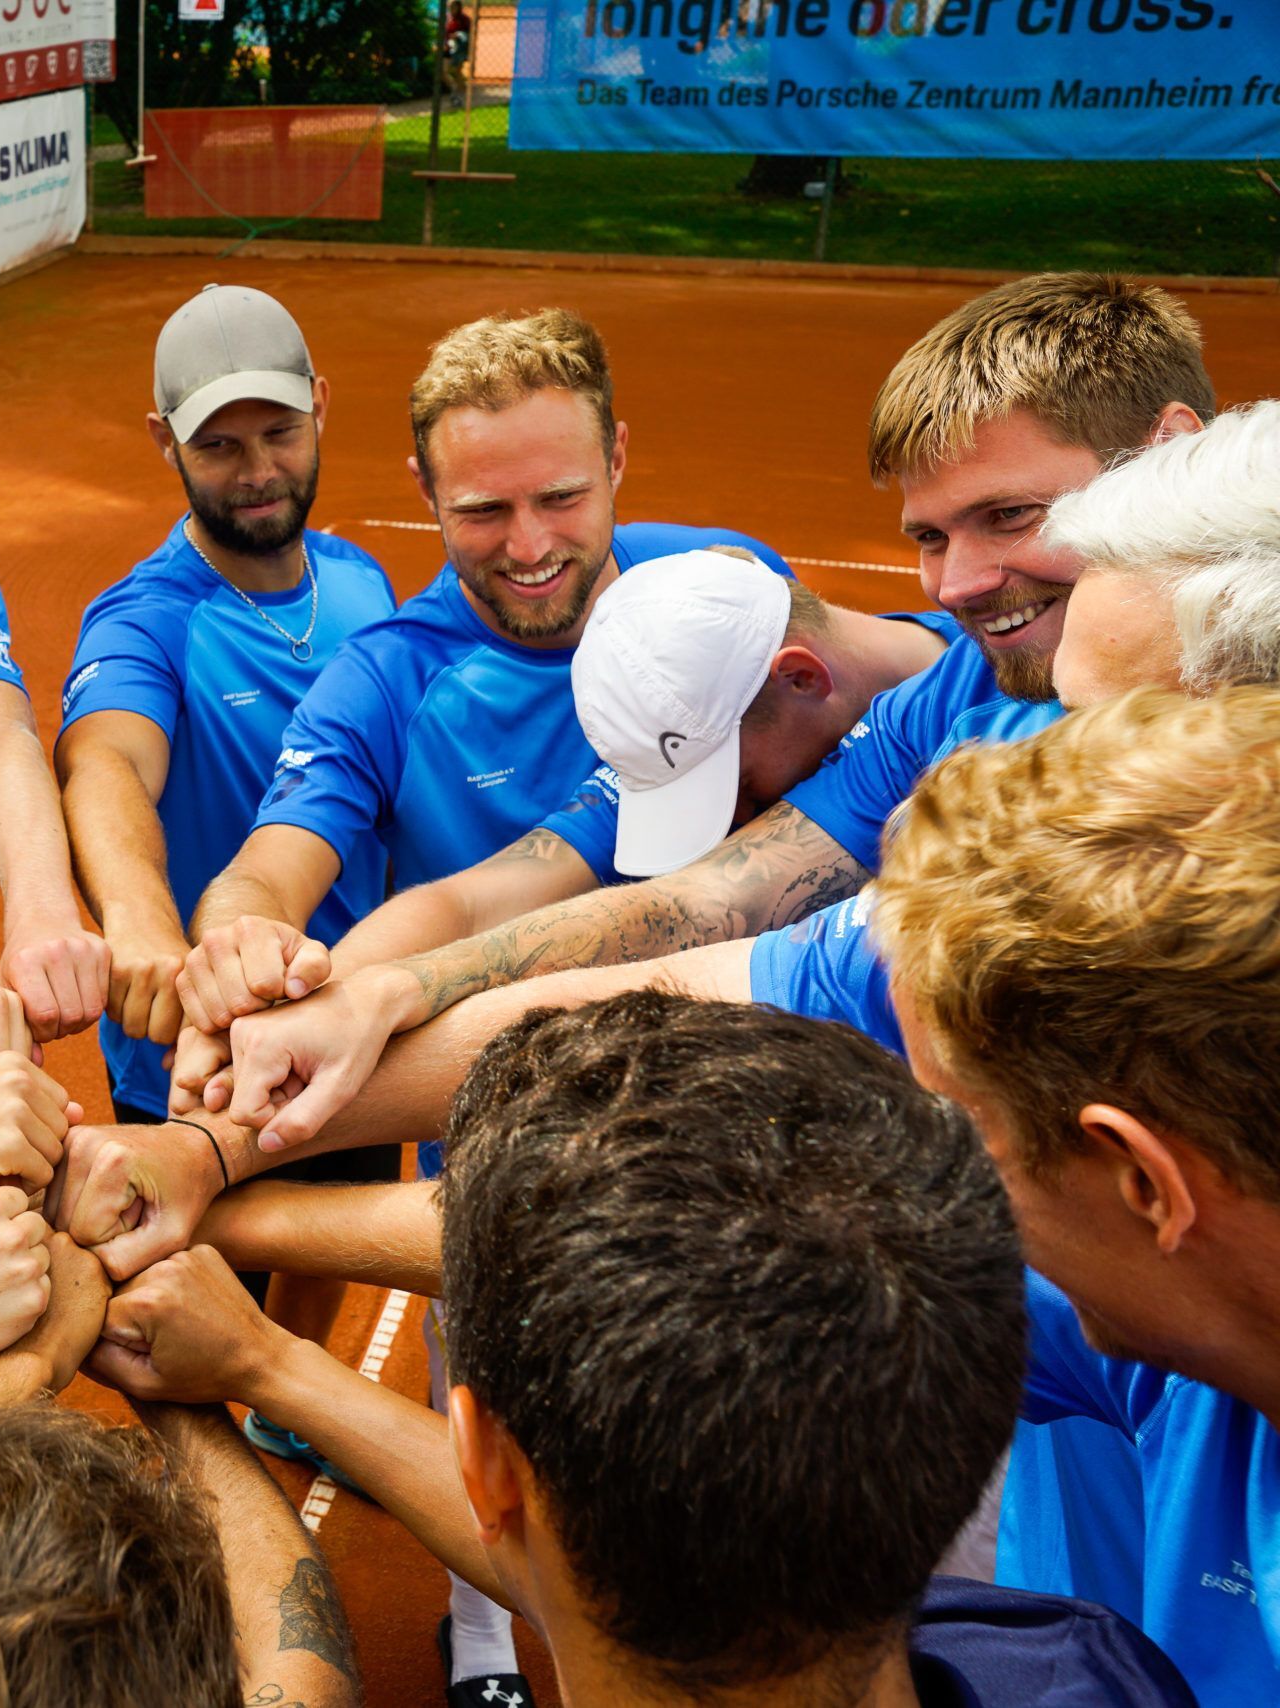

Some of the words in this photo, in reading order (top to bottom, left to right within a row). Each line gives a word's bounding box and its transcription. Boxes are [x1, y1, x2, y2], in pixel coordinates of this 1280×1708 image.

[1016, 0, 1233, 36] cross.
[576, 79, 628, 106] Das
[636, 79, 709, 107] Team
[719, 79, 769, 107] des
[775, 79, 897, 108] Porsche
[904, 80, 1041, 109] Zentrum
[1048, 76, 1233, 109] Mannheim
[1200, 1572, 1246, 1596] BASF
